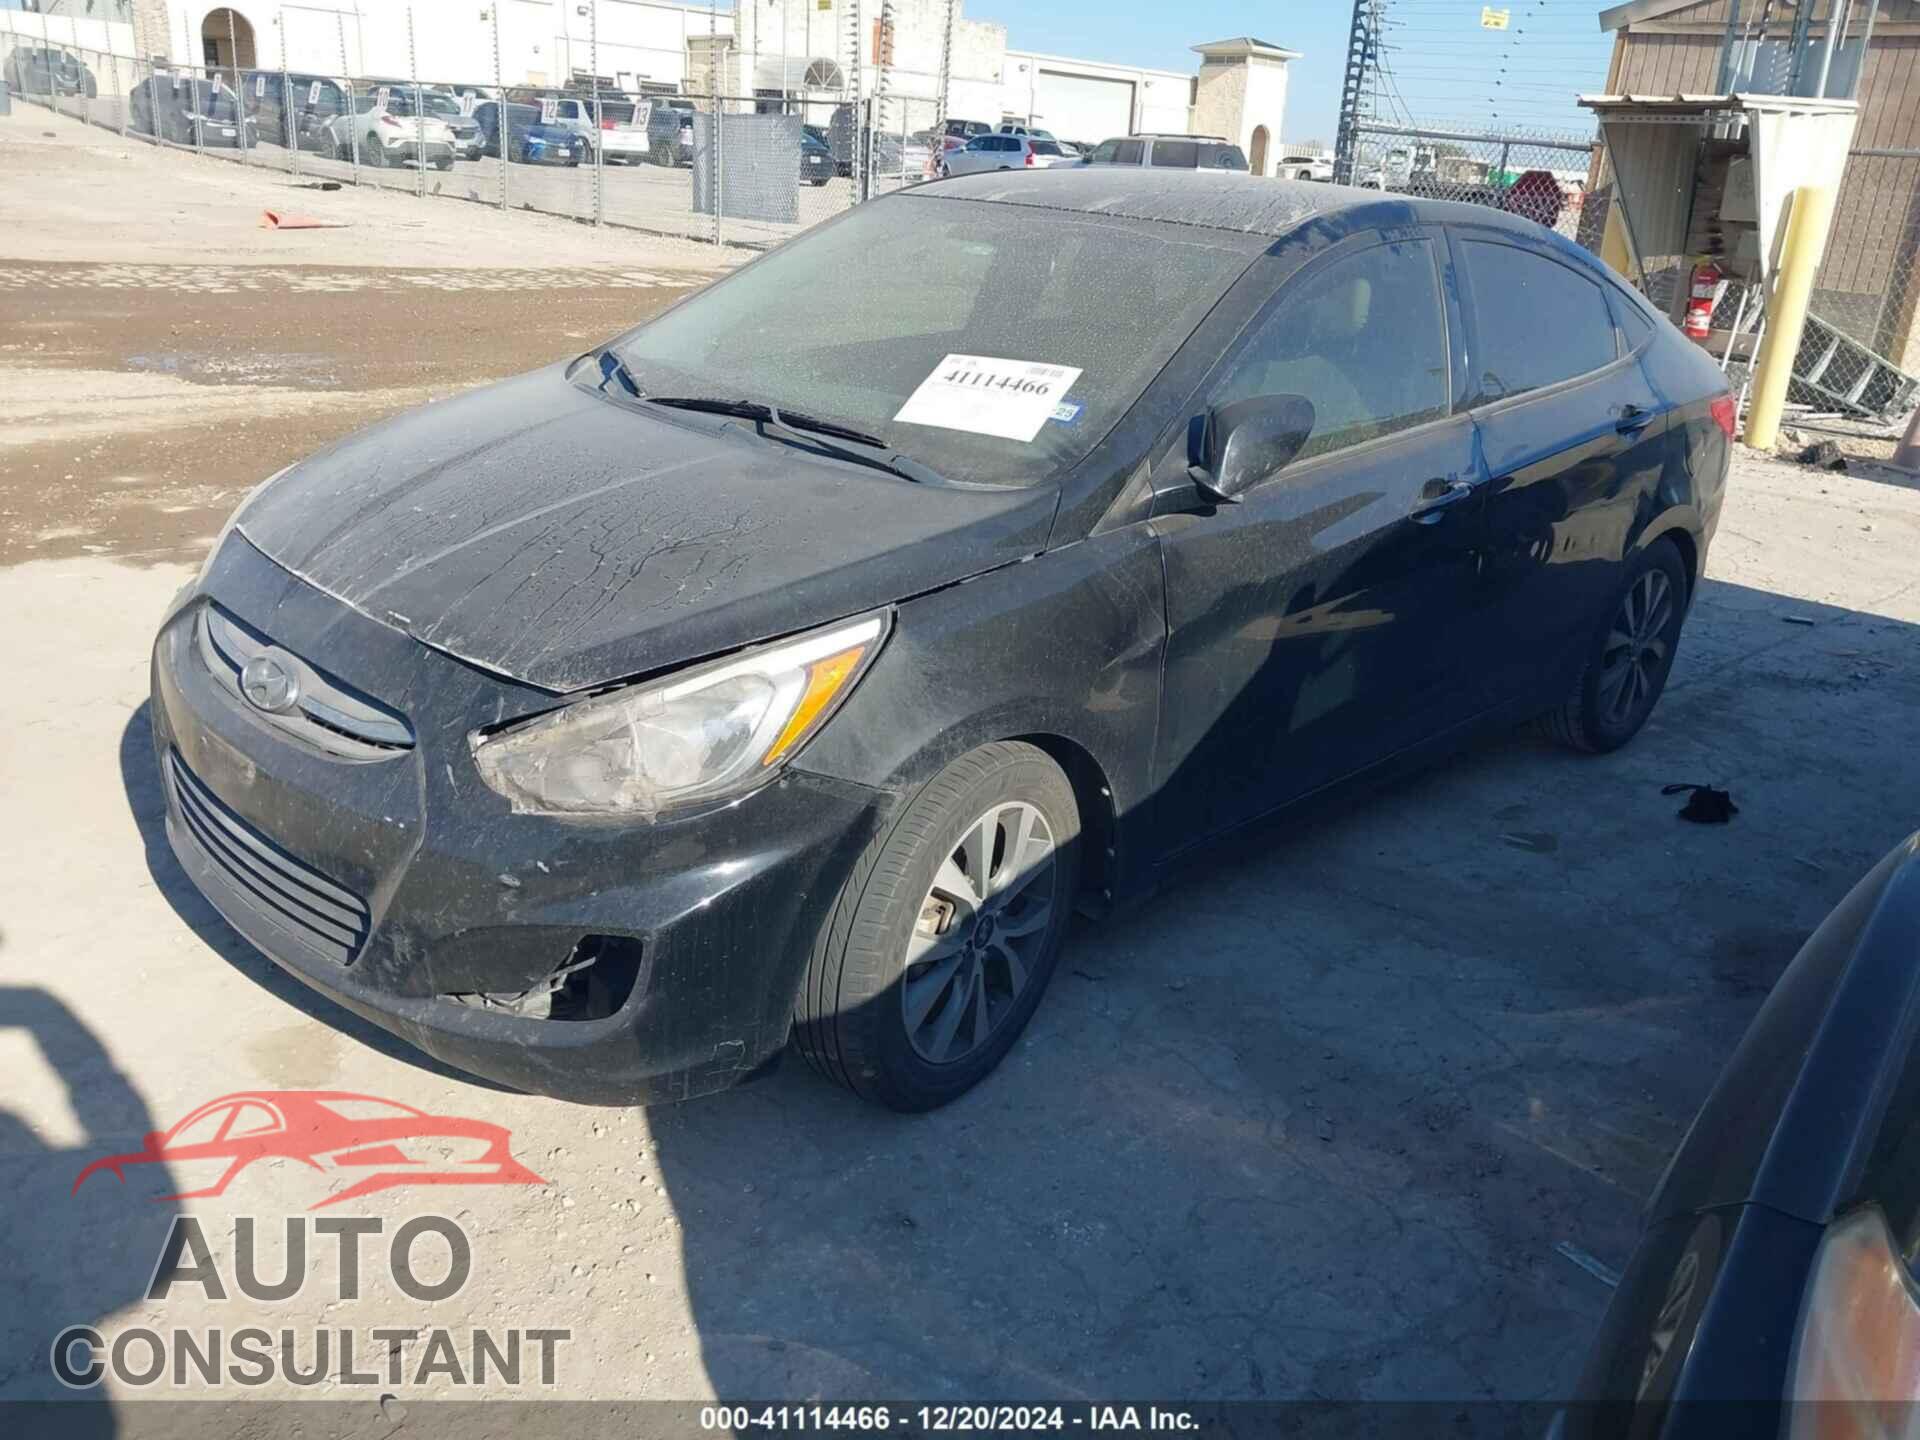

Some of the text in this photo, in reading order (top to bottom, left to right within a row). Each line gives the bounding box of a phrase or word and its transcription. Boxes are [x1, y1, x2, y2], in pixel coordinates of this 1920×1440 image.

[545, 100, 556, 119] 12
[636, 107, 648, 125] 13
[943, 370, 1051, 395] 41114466
